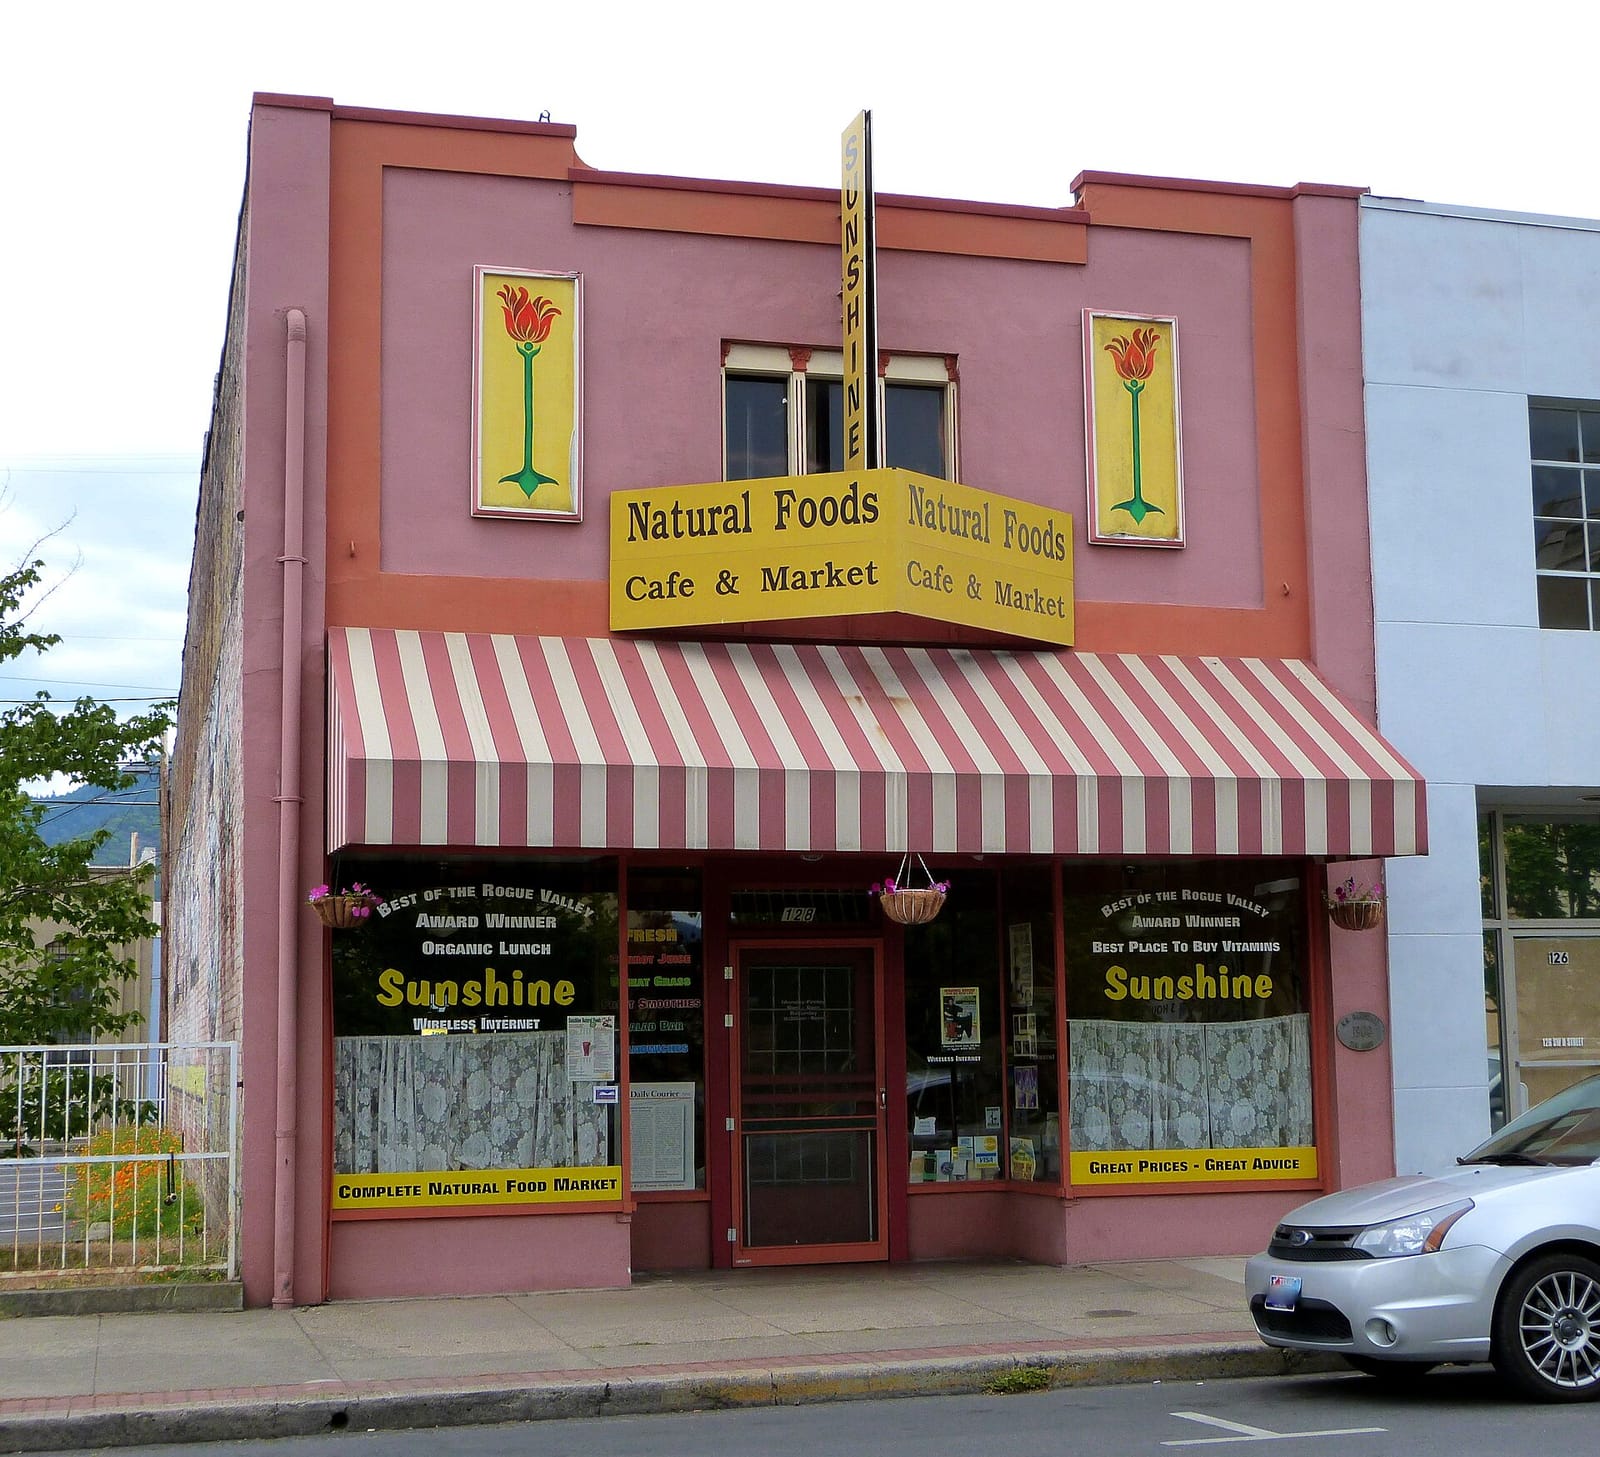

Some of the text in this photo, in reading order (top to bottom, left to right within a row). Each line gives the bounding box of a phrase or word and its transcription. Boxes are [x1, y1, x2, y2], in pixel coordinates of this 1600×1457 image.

[845, 134, 860, 460] SUNSHINE
[627, 482, 879, 542] Natural Foods
[908, 484, 1066, 562] Natural Foods
[625, 560, 879, 601] Cafe & Market
[907, 560, 1065, 619] Cafe & Market
[376, 883, 595, 919] BEST OF THE ROGUE VALLEY
[1101, 889, 1270, 919] BEST OF THE ROGUE VALLEY
[416, 913, 557, 928] AWARD WINNER
[782, 908, 815, 921] 128
[1132, 915, 1241, 928] AWARD WINNER
[627, 929, 677, 942] FRESH
[422, 941, 551, 955] ORGANIC LUNCH
[1092, 940, 1281, 953] BEST PLACE TO BUY VITAMINS
[1549, 952, 1568, 964] 126
[376, 968, 576, 1007] Sunshine
[1104, 963, 1273, 1000] Sunshine
[638, 998, 701, 1009] SMOOTHIES
[413, 1017, 540, 1031] WIRELESS INTERNET
[660, 1020, 684, 1031] BAR
[1089, 1160, 1134, 1174] GREAT
[1139, 1160, 1188, 1173] PRICES
[1205, 1158, 1248, 1172] GREAT
[1252, 1157, 1300, 1170] ADVICE
[338, 1184, 422, 1199] COMPLETE
[428, 1182, 500, 1196] NATURAL
[506, 1179, 547, 1193] FOOD
[554, 1178, 617, 1192] MARKET
